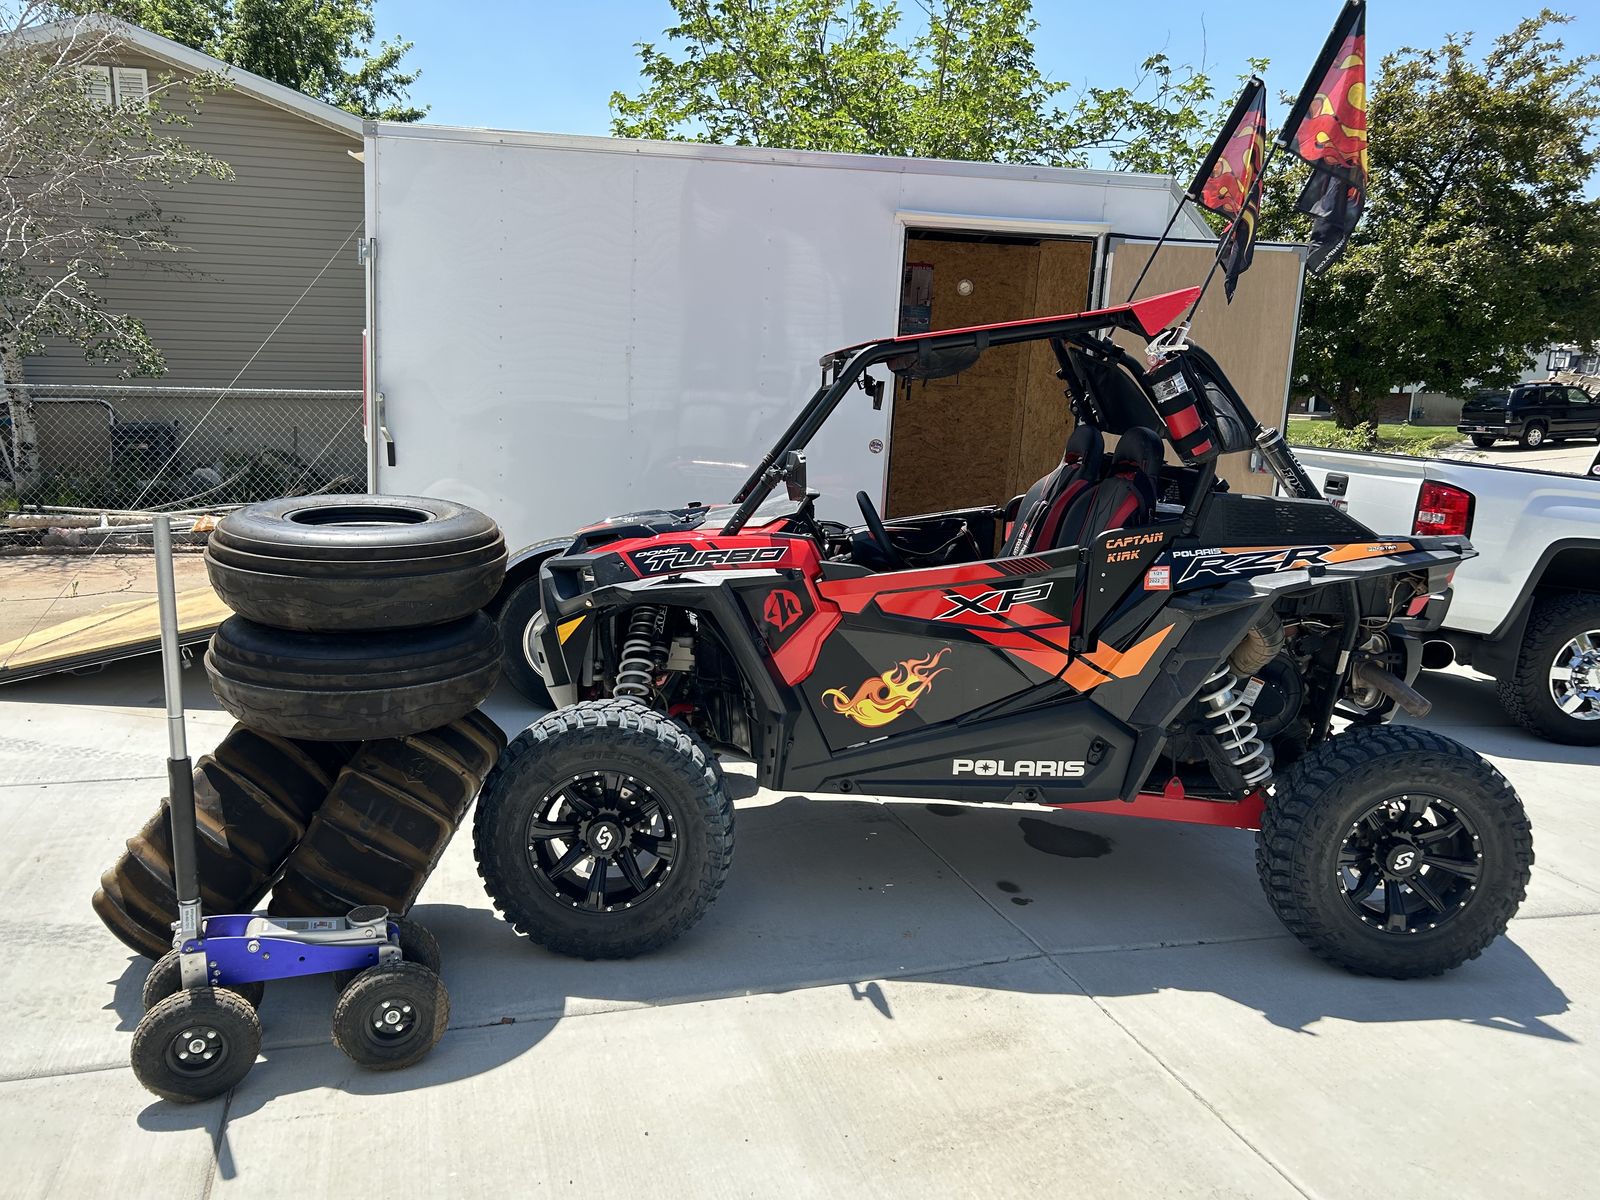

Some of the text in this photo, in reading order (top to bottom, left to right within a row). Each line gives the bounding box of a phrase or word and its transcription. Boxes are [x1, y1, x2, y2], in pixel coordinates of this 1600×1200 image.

[1105, 532, 1164, 549] CAPTAIN
[635, 547, 681, 558] DOHC
[644, 546, 789, 572] TURBO
[1106, 549, 1141, 563] KIRK
[1172, 548, 1222, 558] POLARIS
[1176, 545, 1337, 584] RZR
[931, 581, 1054, 620] XP
[952, 759, 1086, 777] POLARIS
